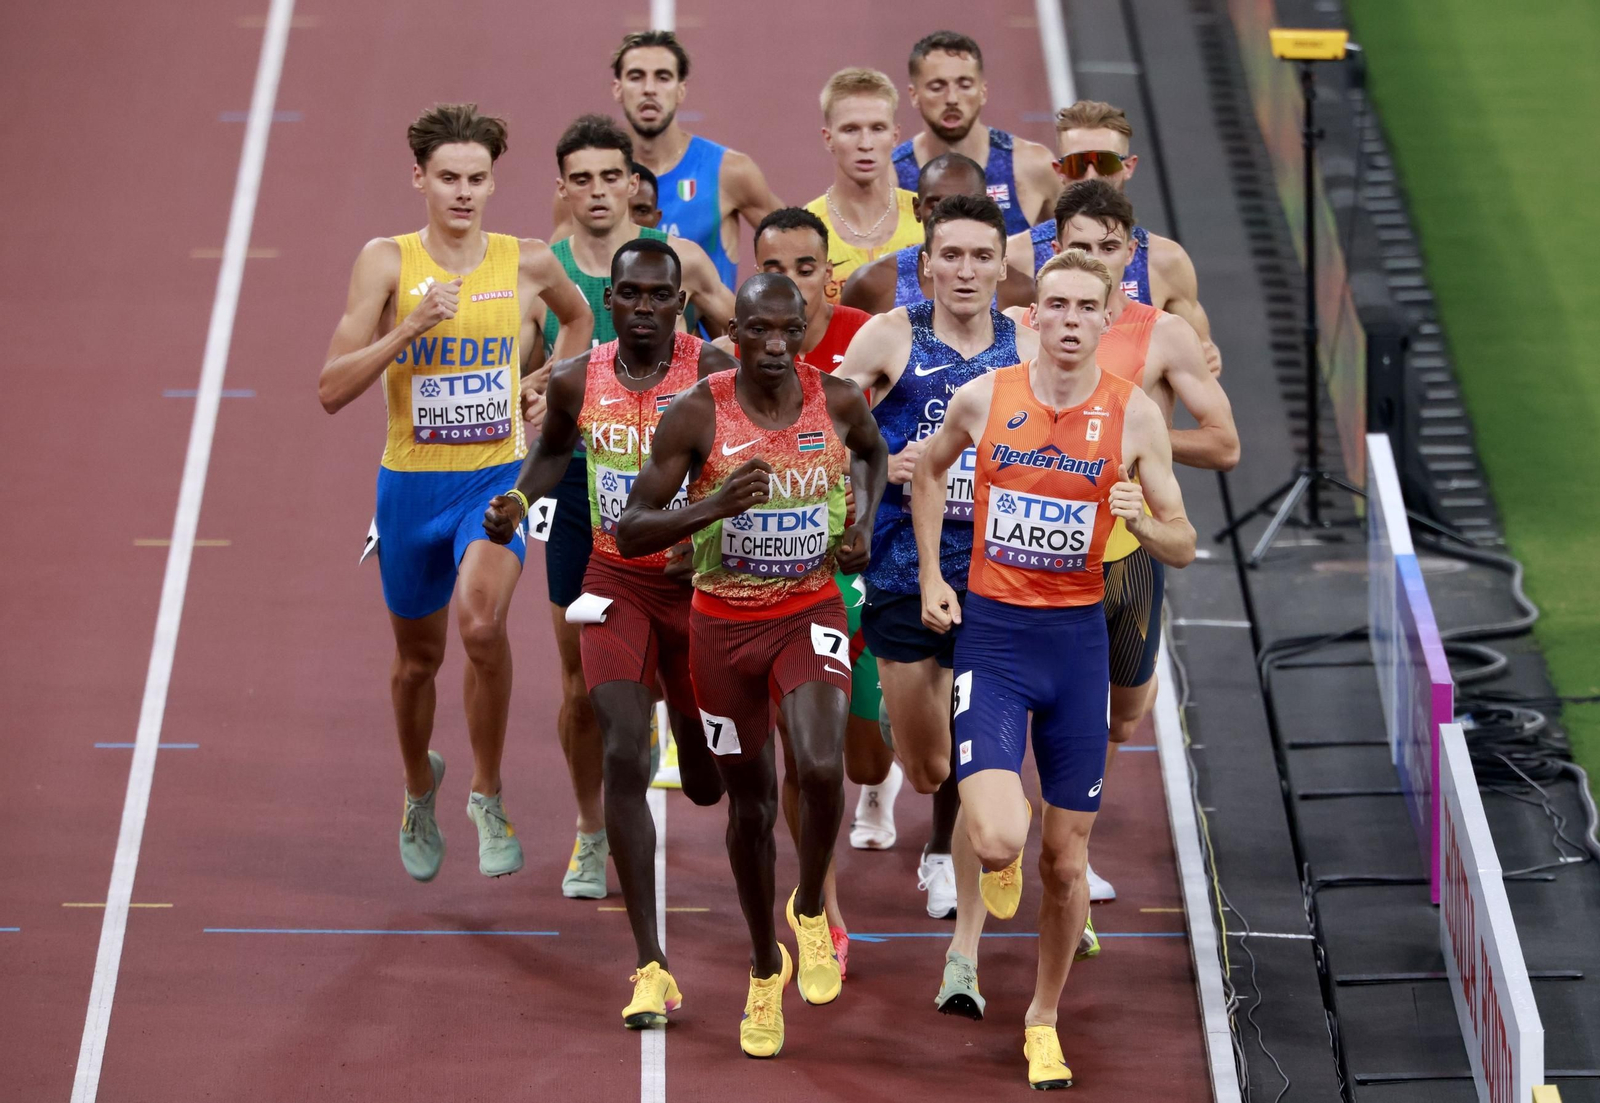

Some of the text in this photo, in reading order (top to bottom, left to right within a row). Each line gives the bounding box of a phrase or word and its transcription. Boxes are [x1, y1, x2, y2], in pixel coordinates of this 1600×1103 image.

[471, 290, 514, 302] BAUHAUS
[439, 370, 505, 396] TDK
[418, 397, 508, 426] PIHLSTRÖM
[592, 421, 656, 455] KEN
[752, 466, 829, 500] NYA
[753, 507, 822, 532] TDK
[1017, 496, 1088, 525] TDK
[726, 532, 825, 557] T. CHERUIYOT
[992, 518, 1085, 552] LAROS
[823, 633, 842, 654] 7
[706, 719, 723, 749] 7
